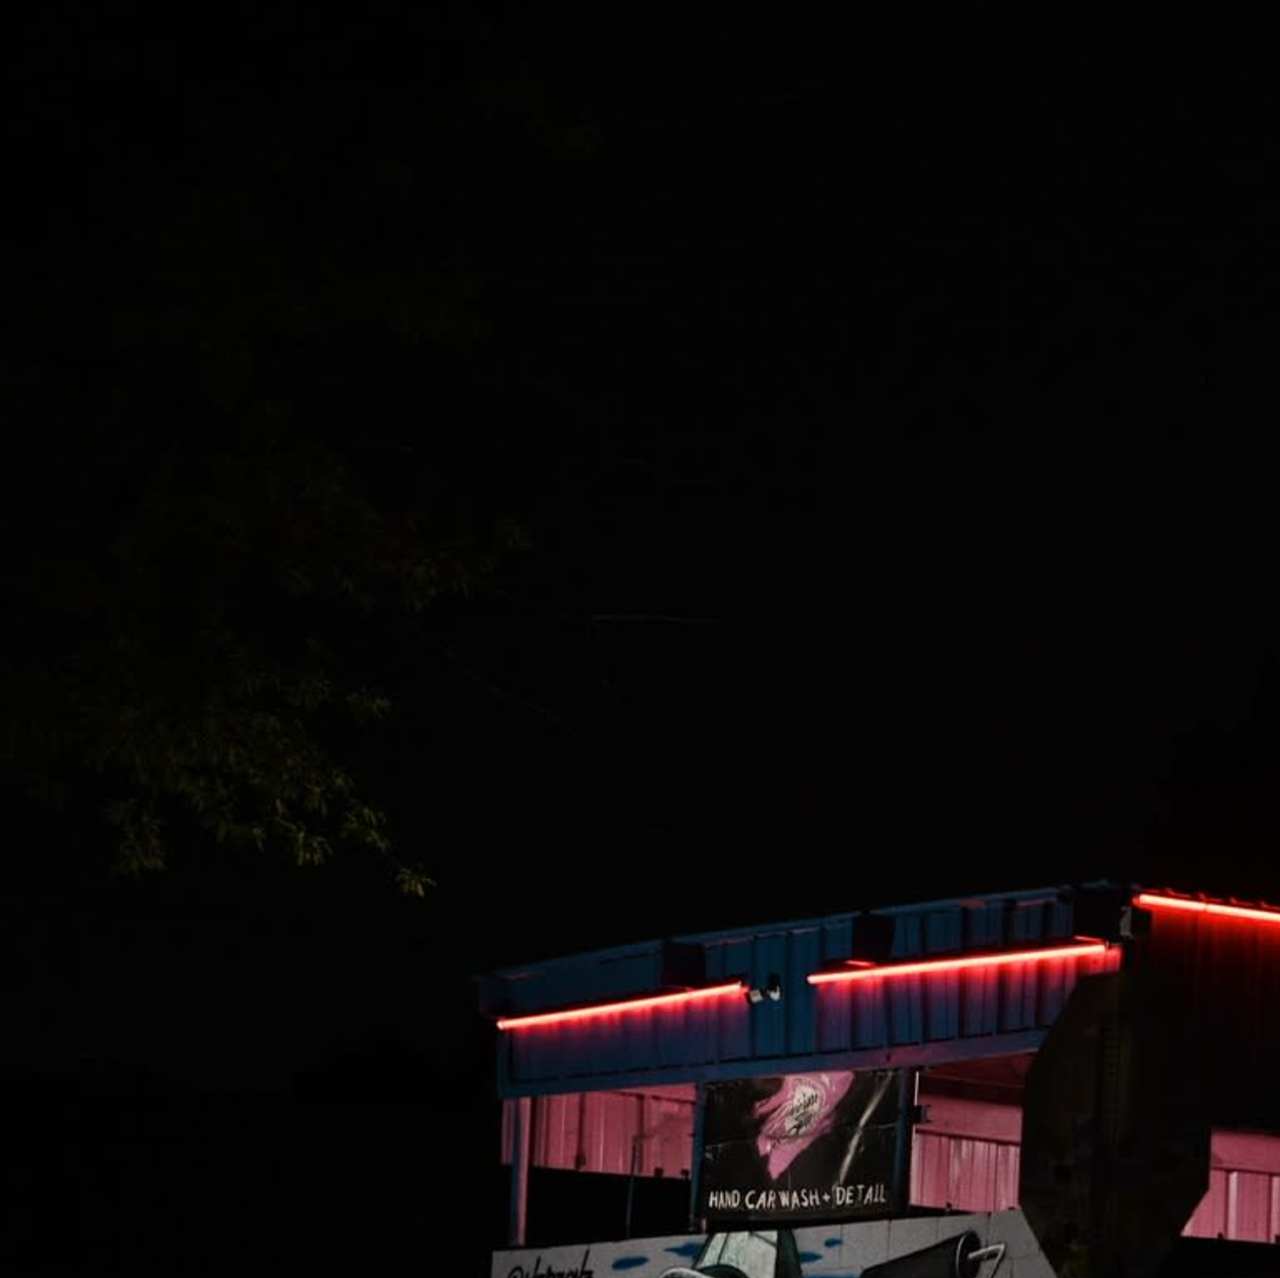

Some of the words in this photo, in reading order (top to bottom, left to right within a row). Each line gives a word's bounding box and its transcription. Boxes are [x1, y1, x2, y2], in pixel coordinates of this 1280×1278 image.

[708, 1190, 740, 1209] HAND
[744, 1189, 776, 1209] CAR
[778, 1188, 820, 1210] WASH
[835, 1184, 886, 1206] DETAIL
